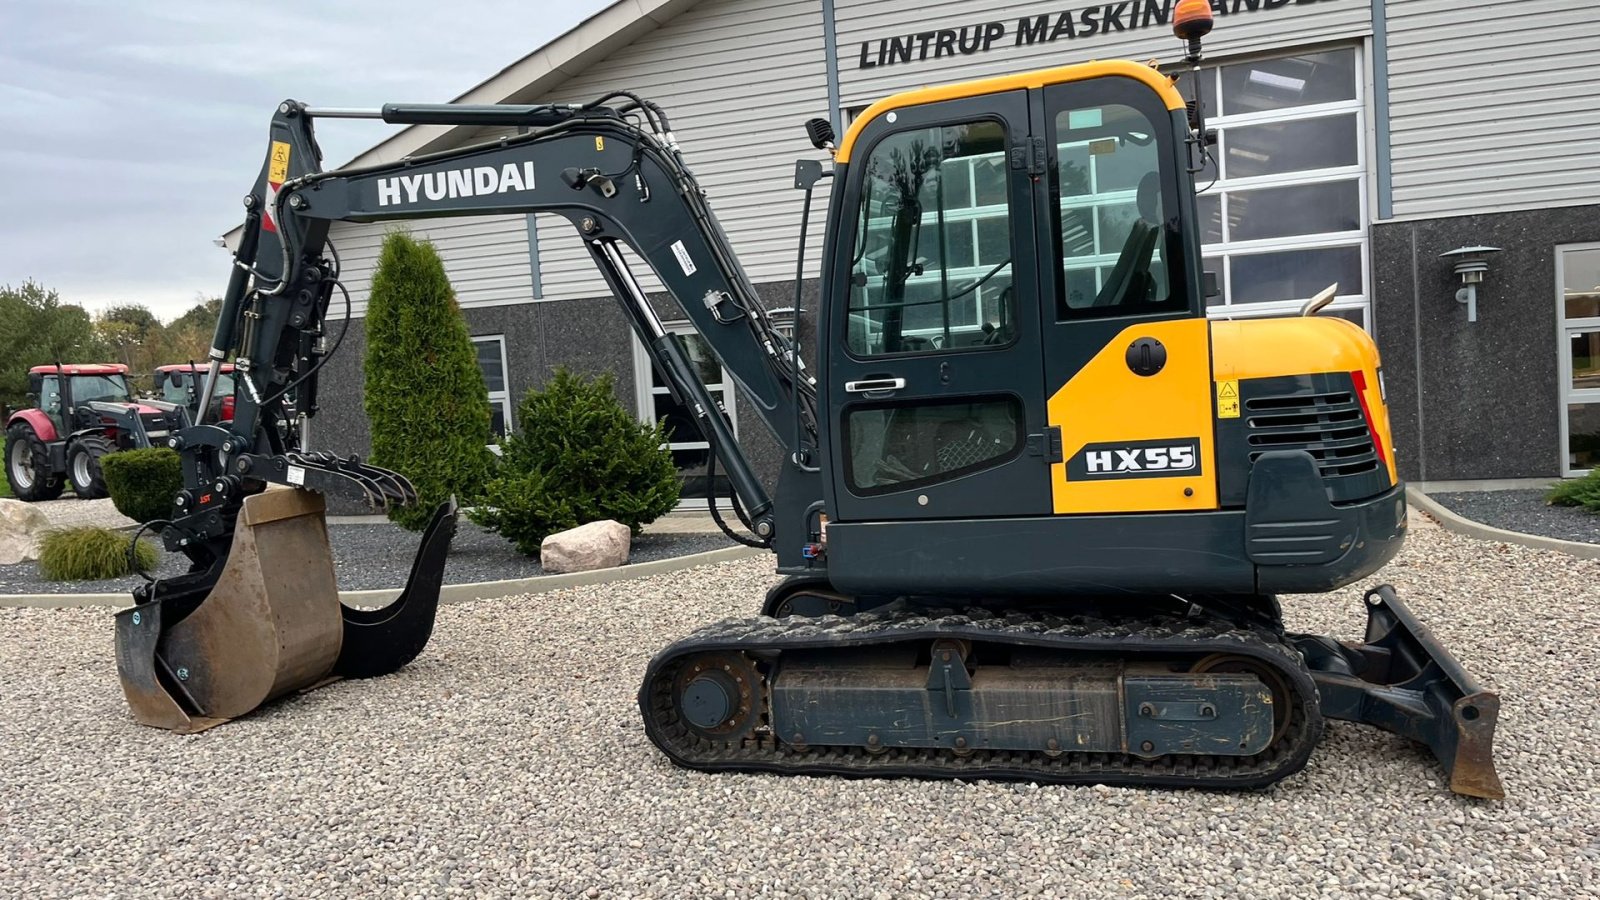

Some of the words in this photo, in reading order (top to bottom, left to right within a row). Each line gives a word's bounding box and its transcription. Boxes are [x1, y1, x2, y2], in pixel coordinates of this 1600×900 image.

[859, 22, 1005, 69] LINTRUP
[377, 161, 536, 206] HYUNDAI
[1085, 446, 1193, 472] HX55
